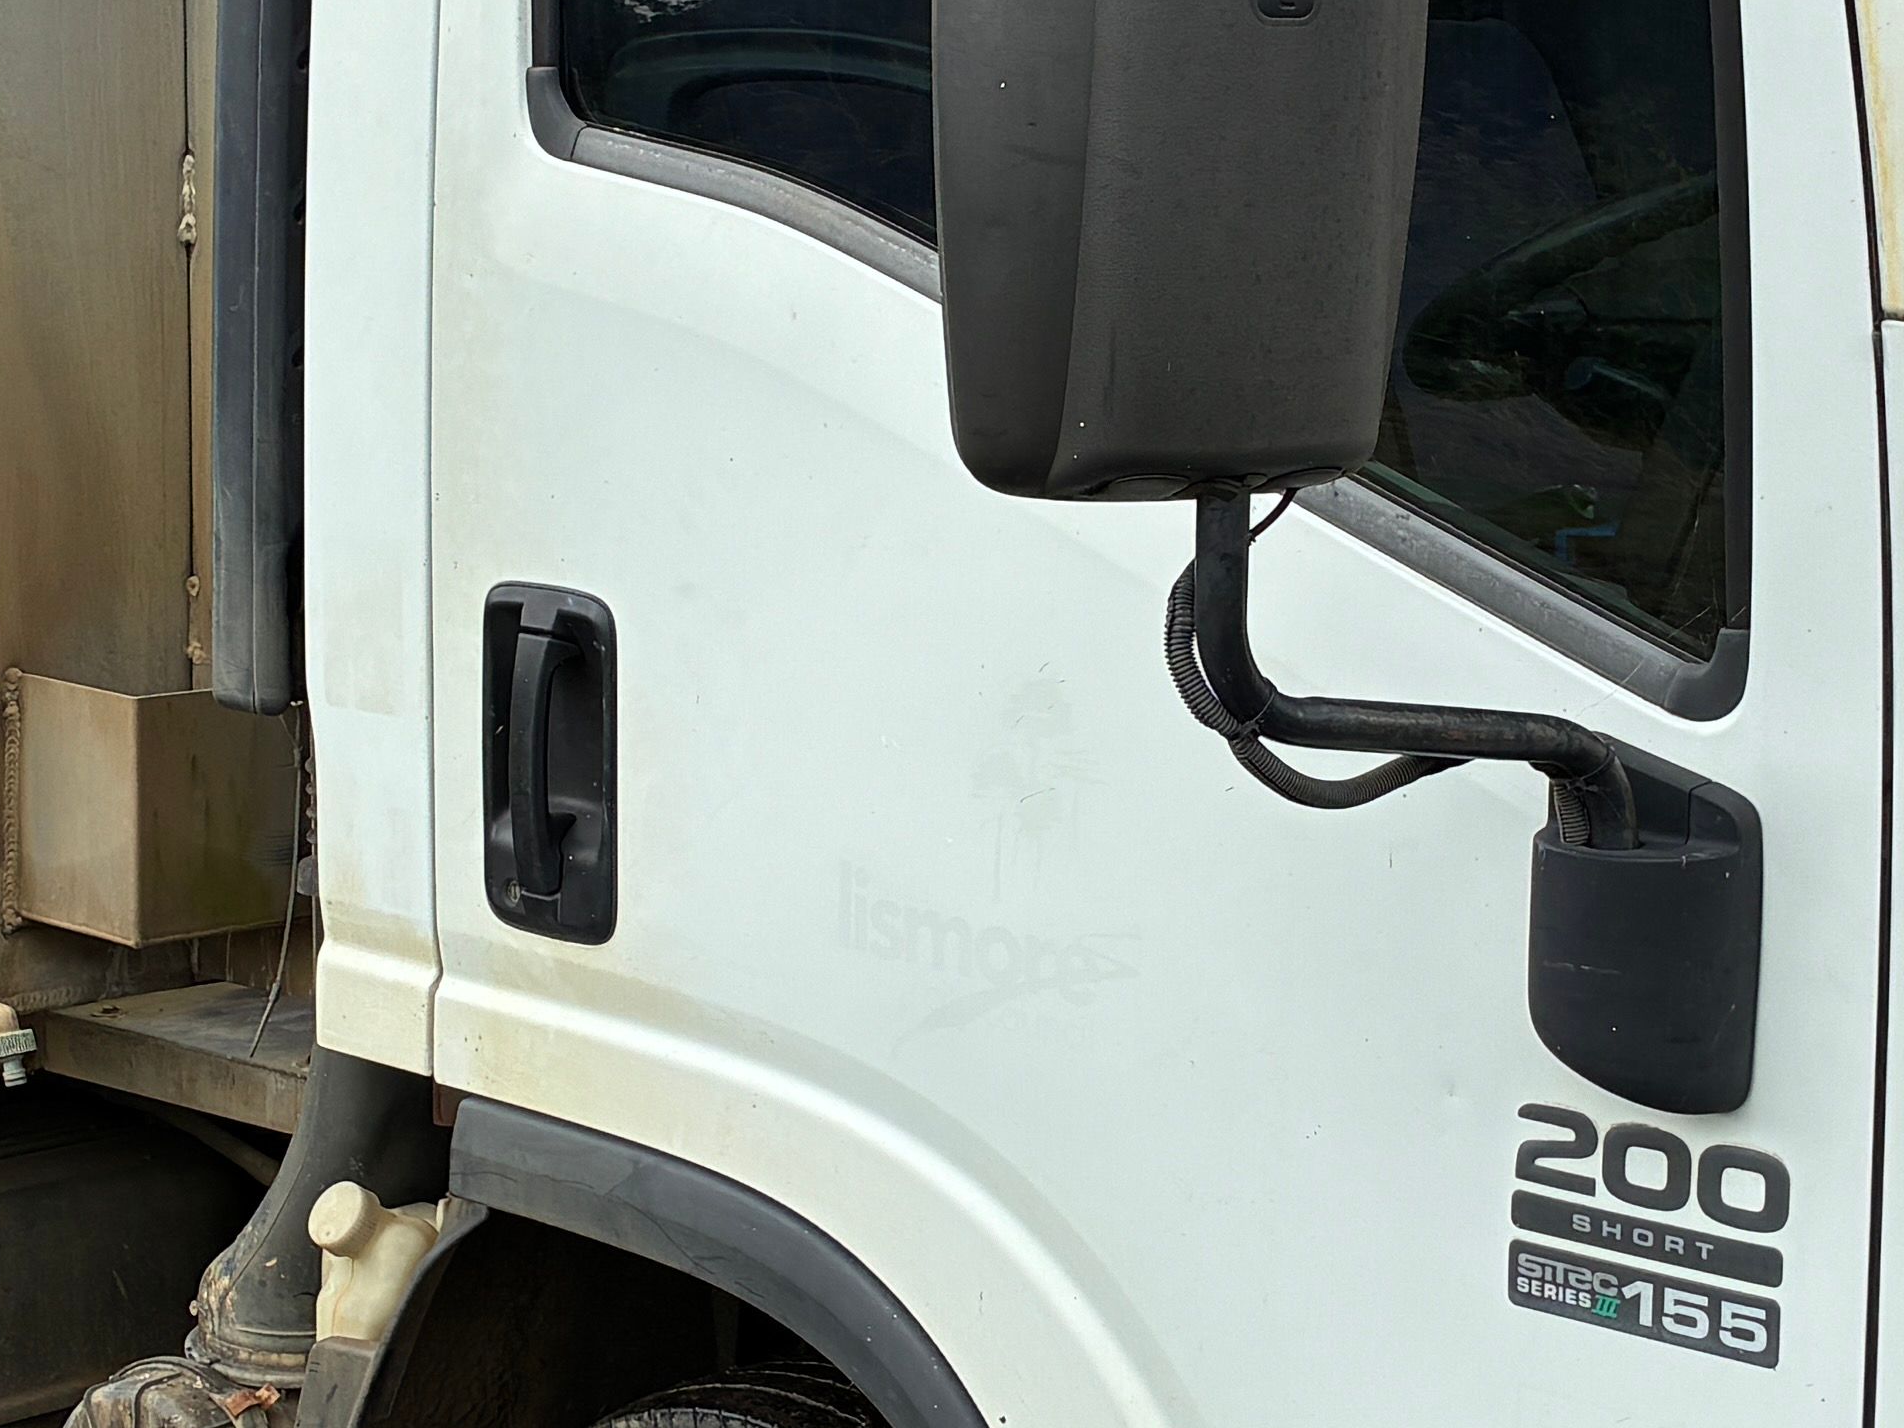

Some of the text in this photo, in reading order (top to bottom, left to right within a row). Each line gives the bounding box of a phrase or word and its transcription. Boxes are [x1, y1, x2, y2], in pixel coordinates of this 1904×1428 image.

[1514, 1102, 1791, 1233] 200
[1572, 1213, 1714, 1260] SHORT
[1516, 1276, 1621, 1318] SERIES III
[1621, 1280, 1767, 1353] 155
